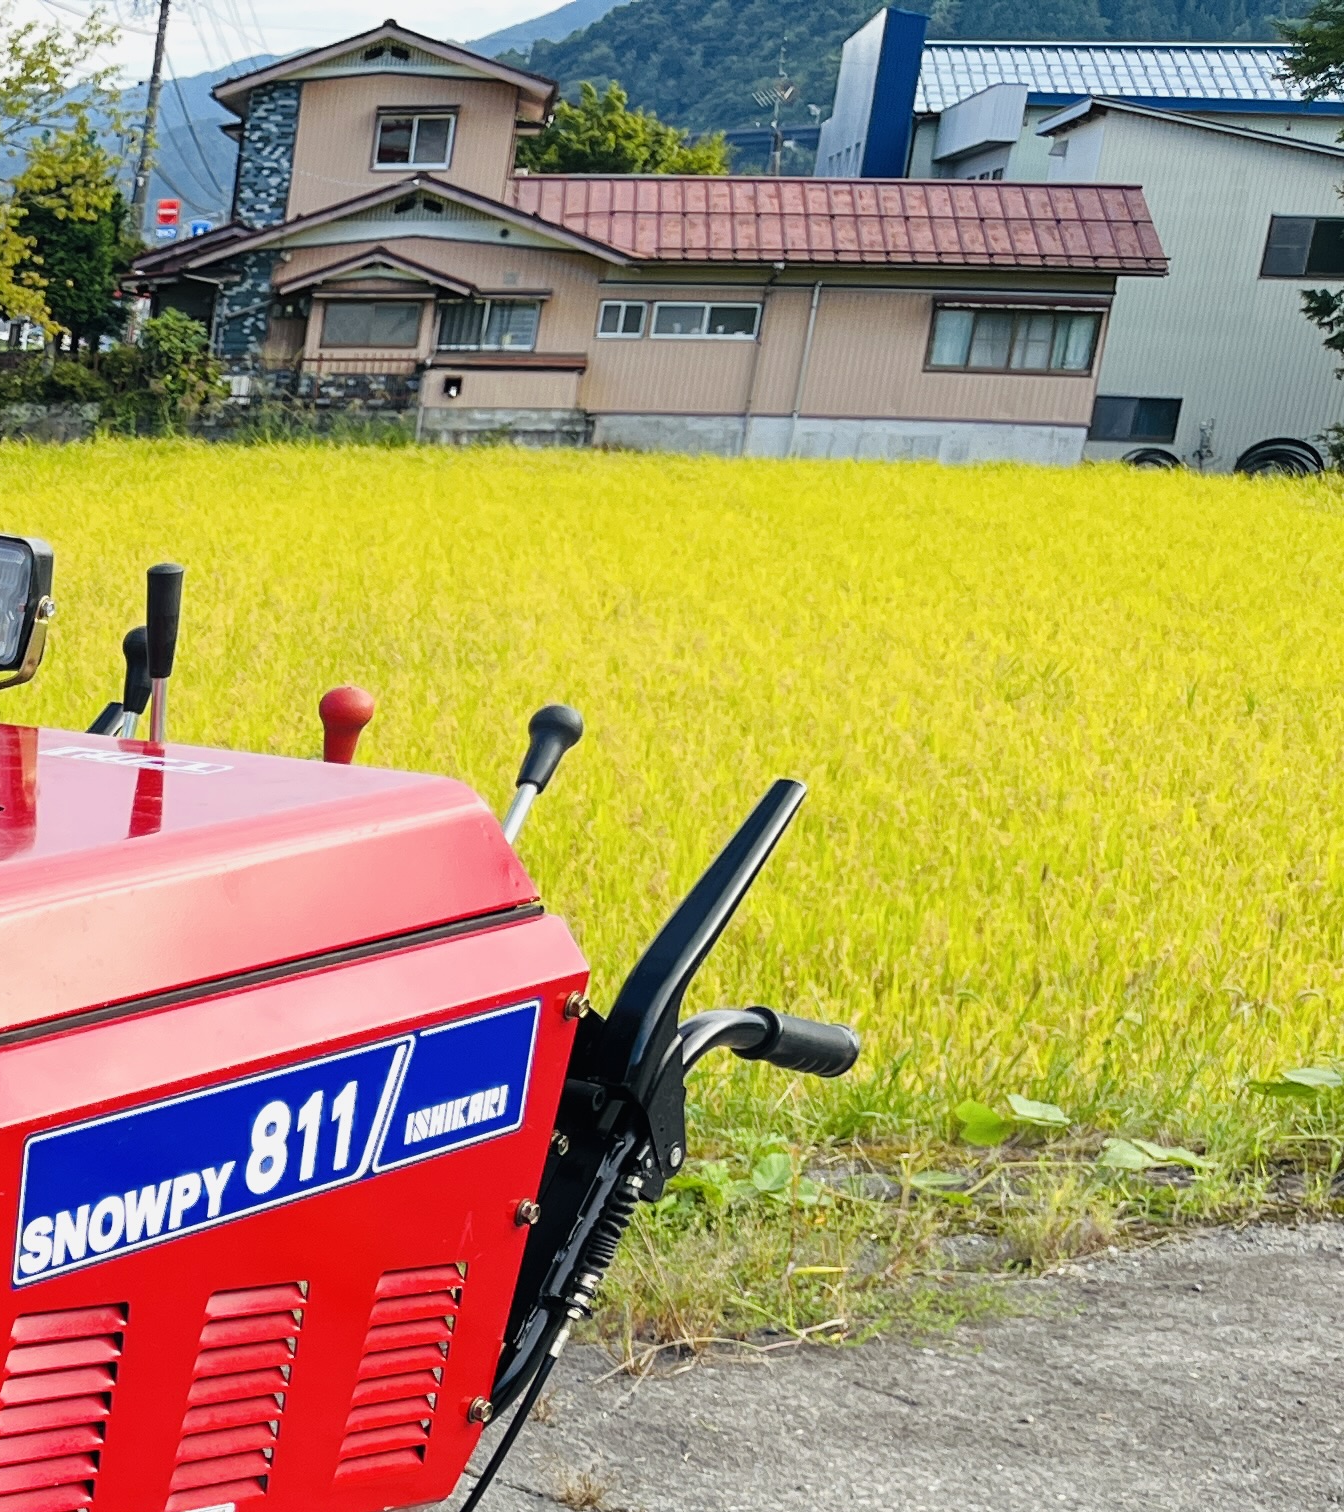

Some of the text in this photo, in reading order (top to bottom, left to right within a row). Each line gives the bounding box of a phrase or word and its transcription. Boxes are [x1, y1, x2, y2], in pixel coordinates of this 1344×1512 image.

[19, 1080, 359, 1275] SNOWPY 811
[404, 1084, 509, 1146] ISHIKARI
